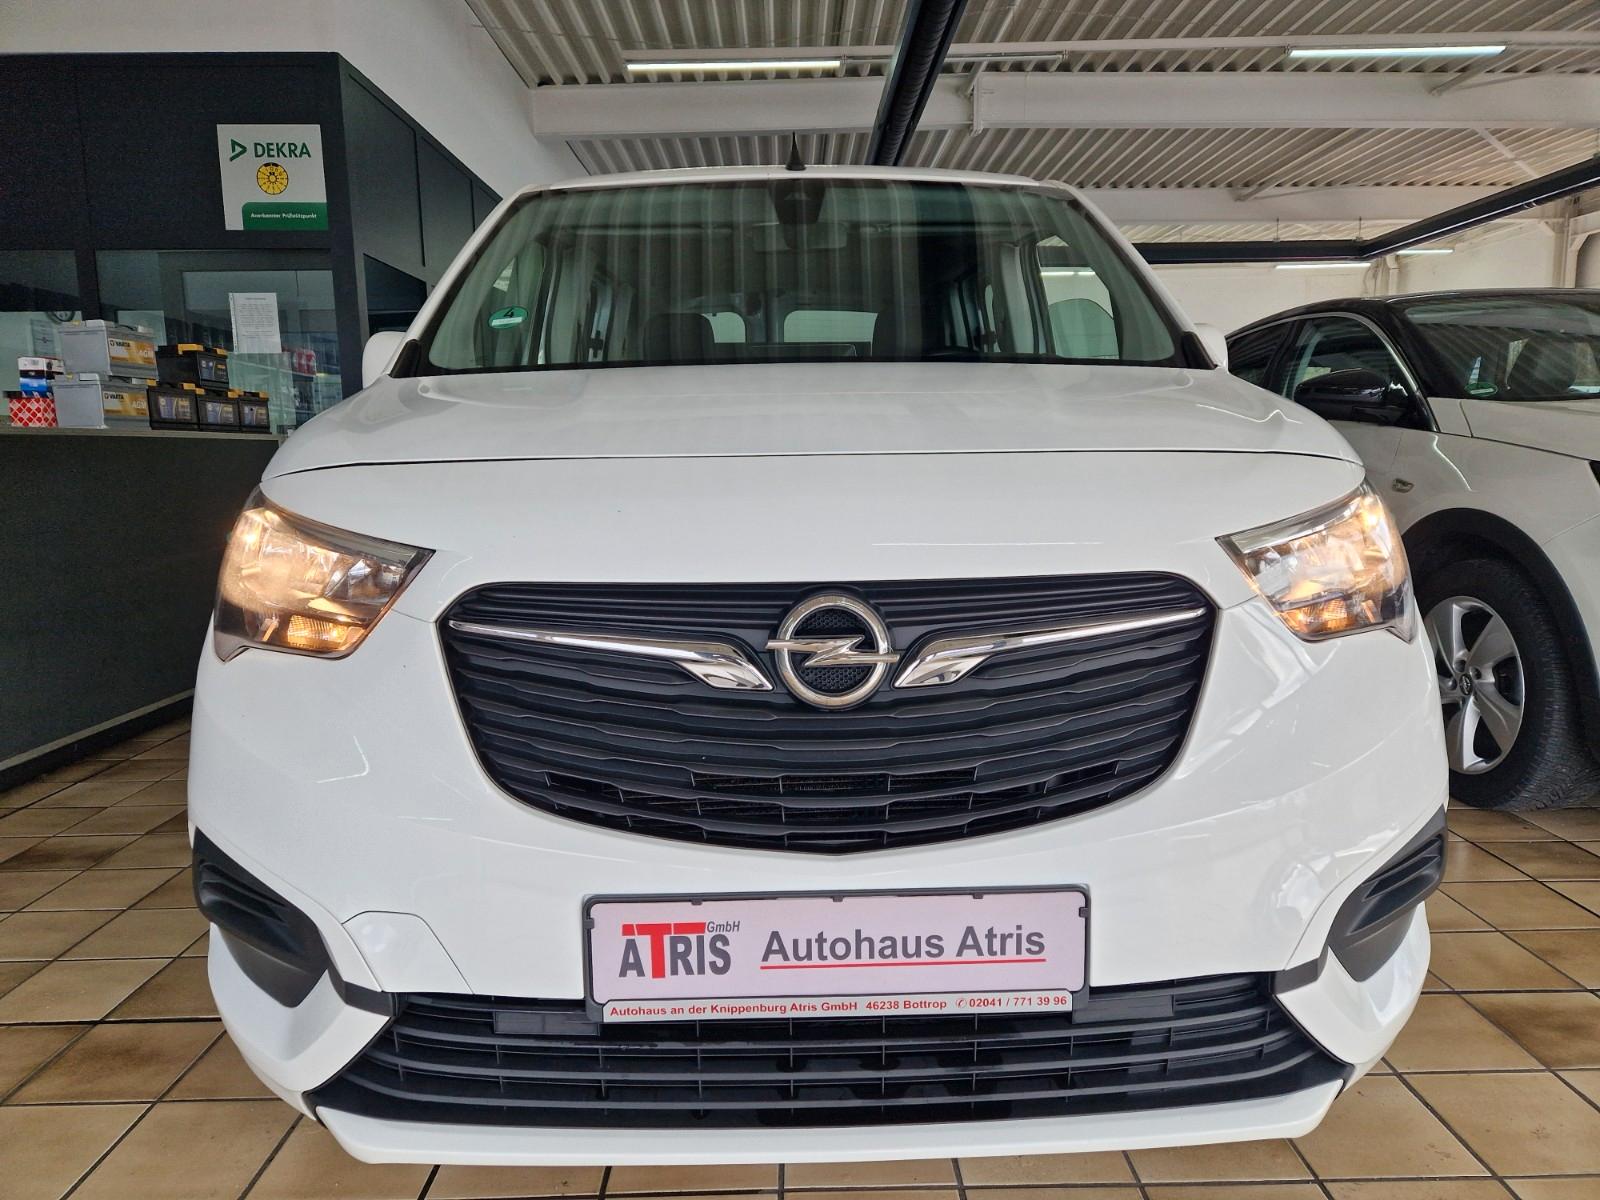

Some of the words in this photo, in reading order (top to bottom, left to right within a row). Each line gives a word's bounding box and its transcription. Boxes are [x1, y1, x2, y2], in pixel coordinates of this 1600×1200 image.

[253, 142, 312, 158] DEKRA
[503, 307, 515, 318] 4
[706, 920, 741, 934] GmbH
[618, 921, 732, 979] ATRIS
[761, 929, 945, 962] Autohaus
[955, 925, 1046, 958] Atris
[610, 1006, 667, 1017] Autohaus
[670, 1007, 685, 1016] an
[688, 1005, 707, 1015] der
[710, 1003, 787, 1014] Knippenburg
[790, 1002, 818, 1013] Atris
[821, 1001, 858, 1012] GmbH
[865, 1000, 900, 1010] 46238
[903, 999, 947, 1010] Bottrop
[969, 997, 1003, 1008] 02041
[1014, 997, 1032, 1007] 771
[1037, 996, 1050, 1006] 39
[1053, 996, 1067, 1006] 96
